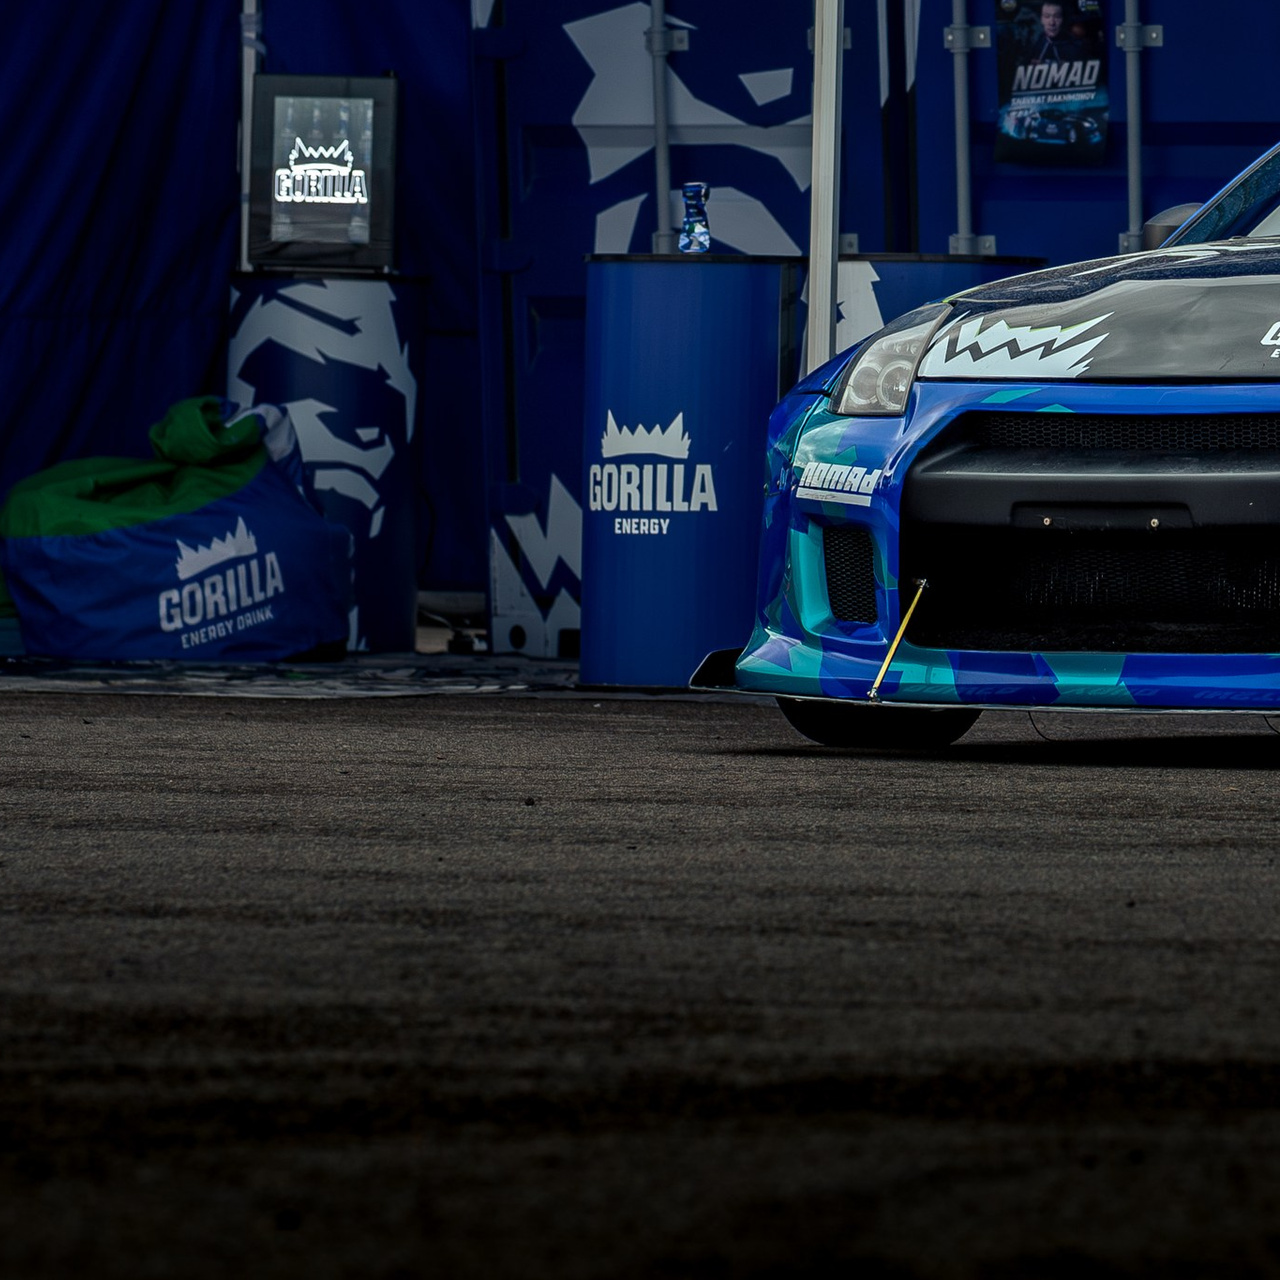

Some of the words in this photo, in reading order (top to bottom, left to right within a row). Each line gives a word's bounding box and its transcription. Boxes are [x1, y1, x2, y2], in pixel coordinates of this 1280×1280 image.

[1012, 59, 1100, 91] NOMAD
[275, 168, 368, 204] GORILLA
[589, 463, 718, 512] GORILLA
[614, 518, 670, 535] ENERGY
[159, 551, 285, 633] GORILLA
[181, 619, 234, 650] ENERGY
[236, 603, 275, 631] DRINK
